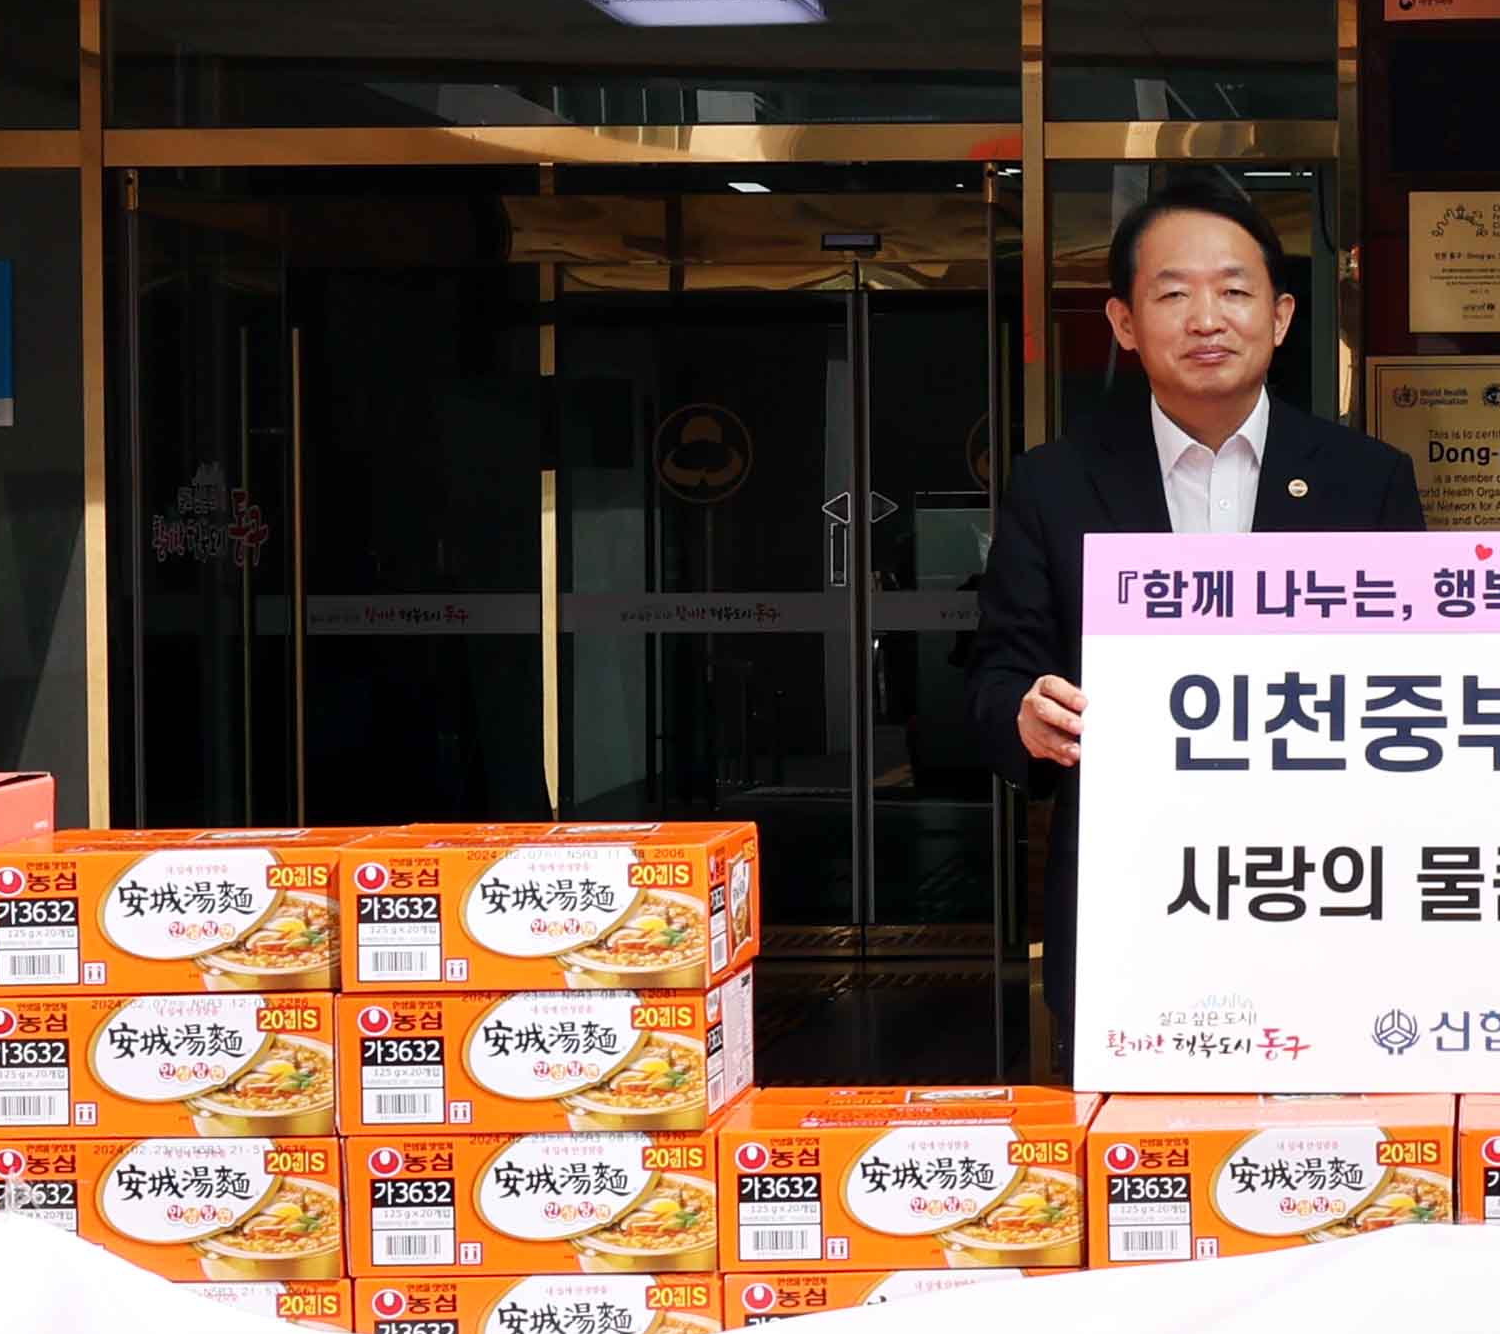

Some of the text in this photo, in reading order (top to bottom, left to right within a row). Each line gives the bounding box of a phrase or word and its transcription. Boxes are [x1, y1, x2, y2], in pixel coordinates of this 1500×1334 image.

[1428, 430, 1449, 439] This
[1451, 430, 1460, 439] is
[1454, 473, 1492, 483] member
[1443, 487, 1474, 497] Health
[1437, 501, 1476, 511] Network
[1479, 501, 1493, 511] for
[1452, 515, 1472, 525] and
[1256, 567, 1414, 623] 나누는,
[26, 873, 76, 892] 농심
[390, 869, 438, 888] 농심
[1168, 846, 1382, 922] 사랑의
[119, 881, 254, 916] 安城湯麵
[481, 878, 615, 913] 安城湯麵
[0, 901, 75, 924] 가3632
[361, 897, 437, 920] 가3632
[1157, 1011, 1189, 1026] 살고
[1190, 1011, 1219, 1026] 싶은
[109, 1023, 244, 1058] 安城湯麵
[1106, 1027, 1312, 1060] 활기찬 행복도시 동구
[403, 1153, 453, 1172] 농심
[772, 1149, 819, 1167] 농심
[495, 1162, 628, 1197] 安城湯麵
[861, 1157, 996, 1192] 安城湯麵
[375, 1182, 451, 1205] 가3632
[740, 1177, 819, 1204] 가3632
